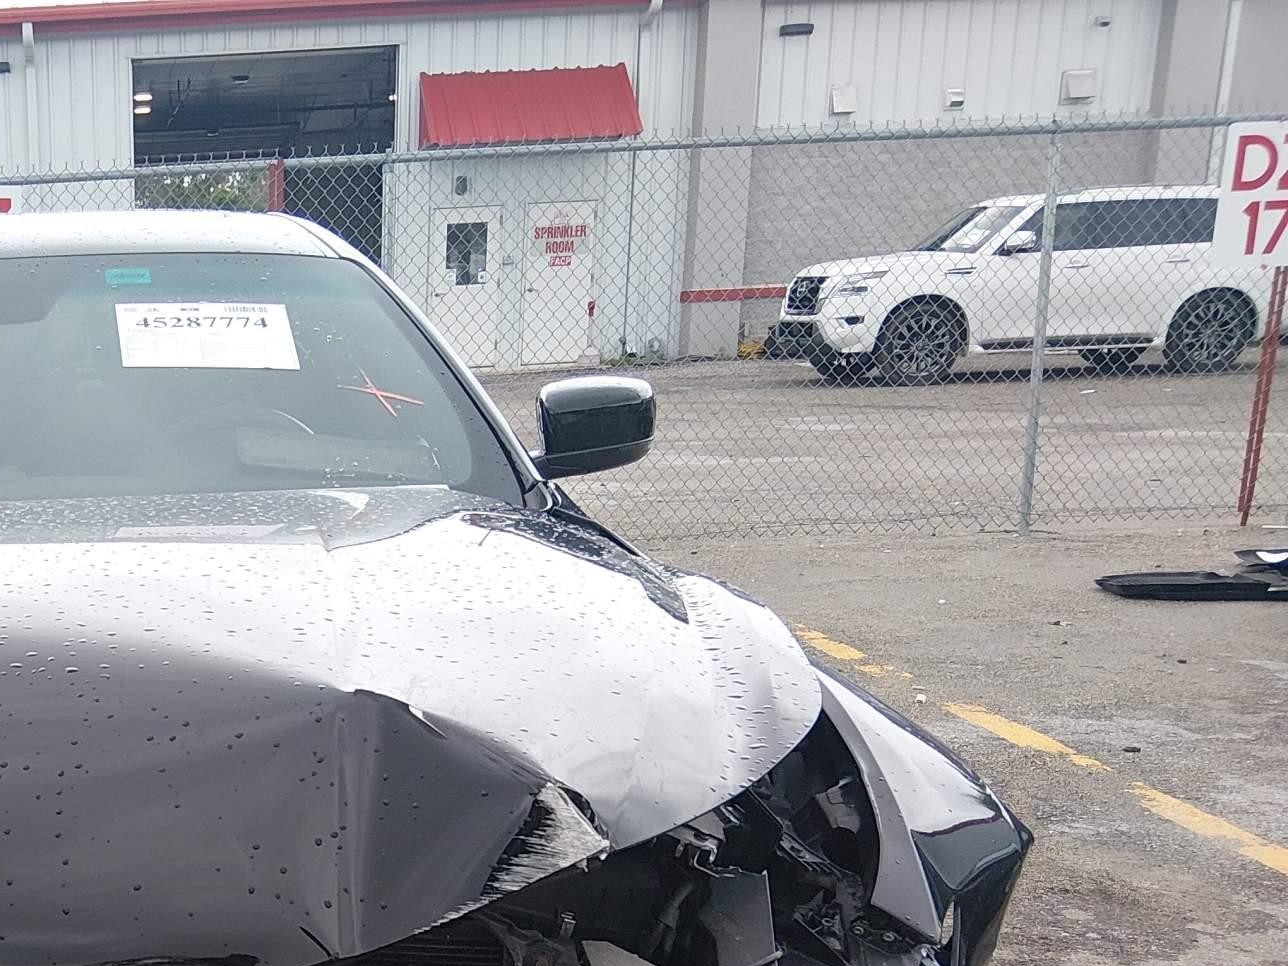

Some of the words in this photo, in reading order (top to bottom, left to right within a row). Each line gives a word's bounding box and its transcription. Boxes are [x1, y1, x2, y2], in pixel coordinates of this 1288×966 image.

[533, 224, 588, 240] SPRINKLER
[545, 240, 575, 254] ROOM
[135, 316, 269, 329] 45287774
